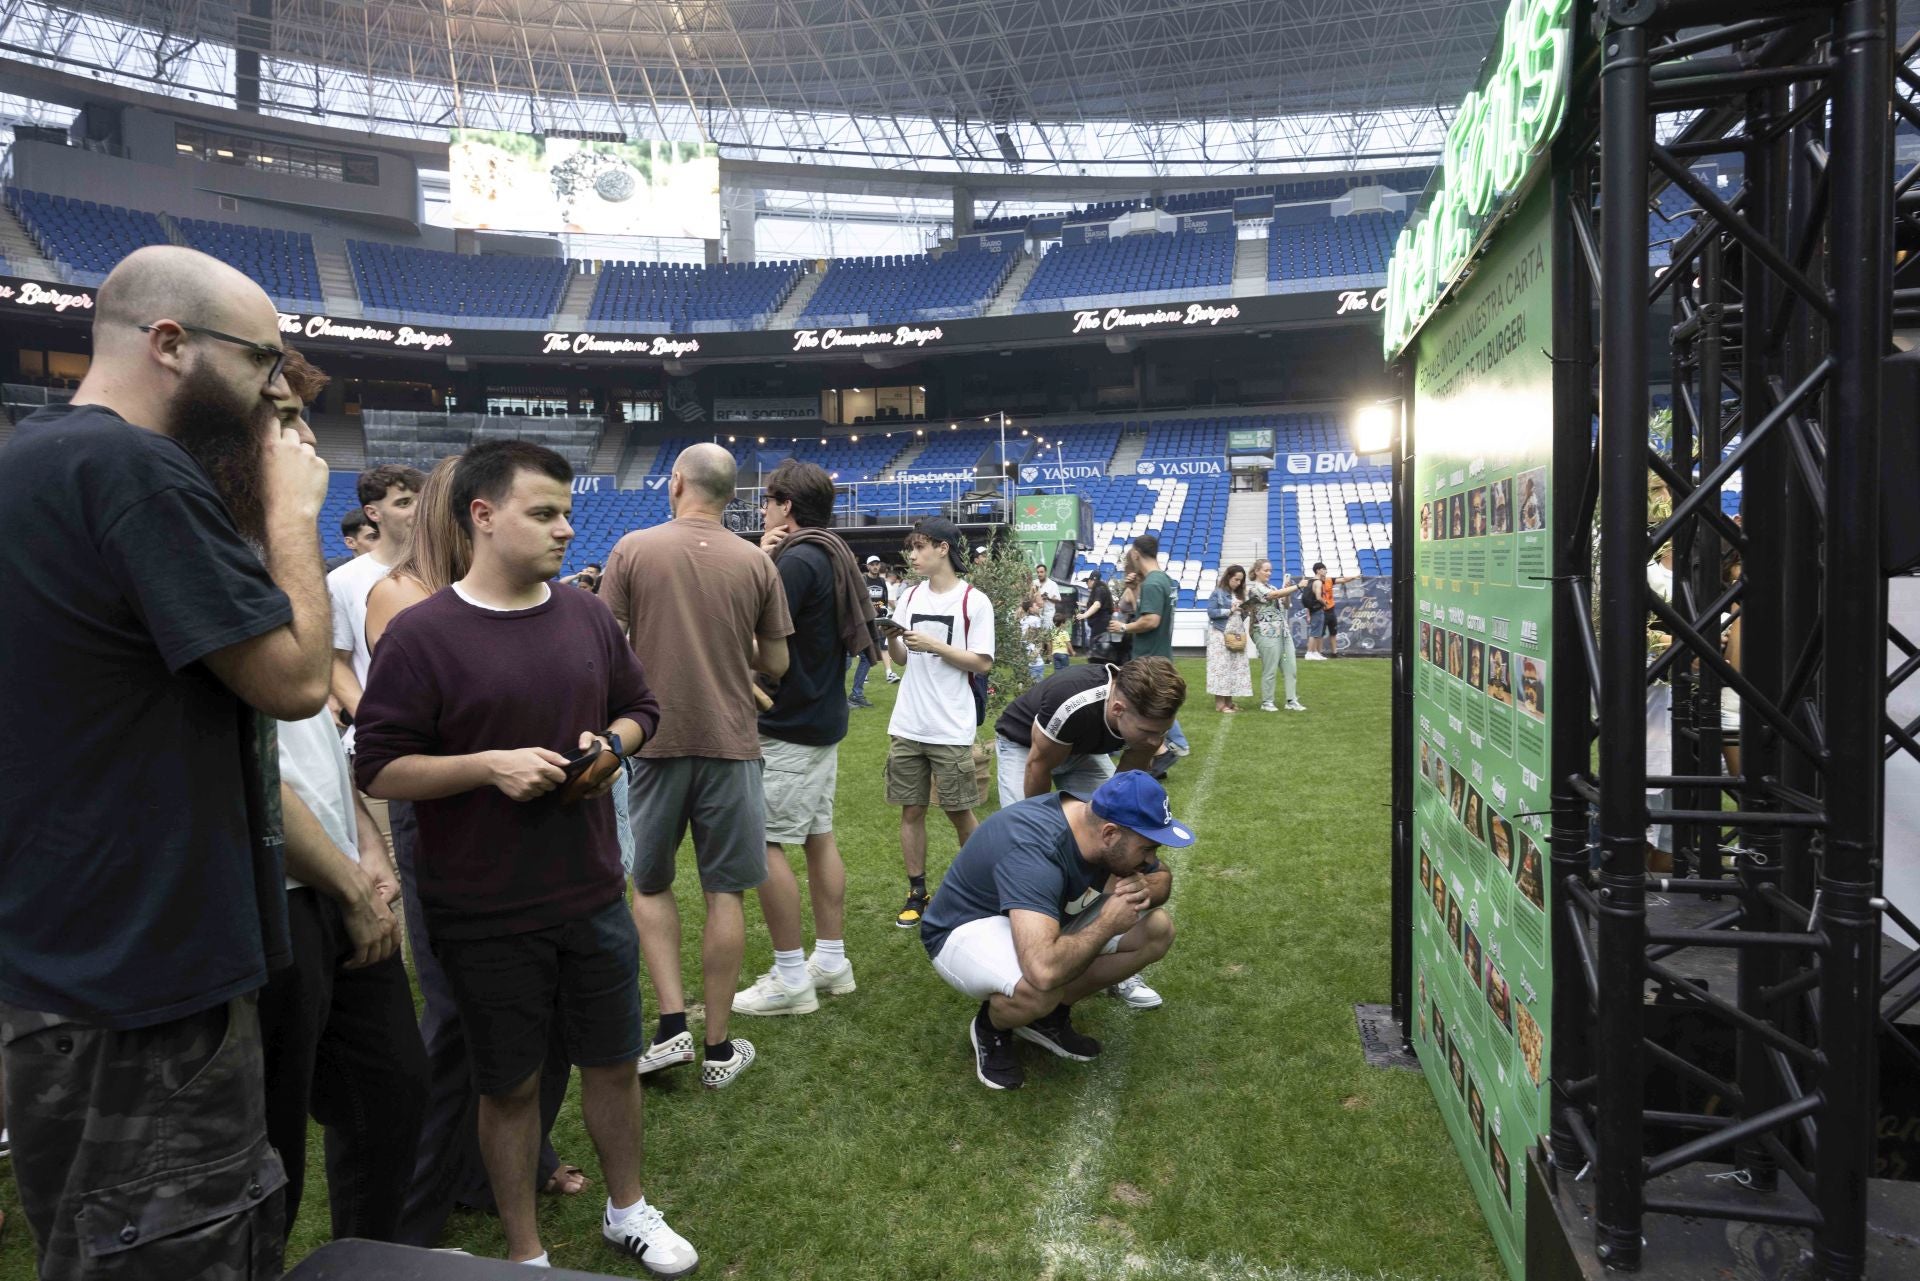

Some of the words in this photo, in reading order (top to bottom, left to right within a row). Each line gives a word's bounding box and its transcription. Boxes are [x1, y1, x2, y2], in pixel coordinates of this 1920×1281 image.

[15, 282, 94, 312] Burger
[1336, 290, 1369, 314] The
[1447, 330, 1461, 364] OJO
[1466, 283, 1504, 344] NUESTRA
[1506, 241, 1545, 305] CARTA
[1072, 310, 1101, 334] The
[1103, 308, 1183, 331] Champions
[1183, 303, 1240, 325] Burger
[277, 312, 303, 333] The
[305, 316, 395, 340] Champions
[394, 326, 452, 350] Burger
[793, 330, 819, 351] The
[821, 328, 893, 349] Champions
[893, 326, 943, 346] Burger
[1475, 346, 1486, 377] TU
[1486, 309, 1527, 370] BURGER!
[543, 333, 571, 353] The
[573, 333, 650, 353] Champions
[649, 337, 699, 358] Burger
[715, 410, 747, 420] REAL
[752, 408, 816, 420] SOCIEDAD
[1042, 466, 1102, 480] YASUDA
[1160, 461, 1222, 475] YASUDA
[1315, 453, 1359, 473] BM
[896, 468, 974, 485] finetwork
[1015, 521, 1057, 532] eineken
[1360, 597, 1379, 611] The
